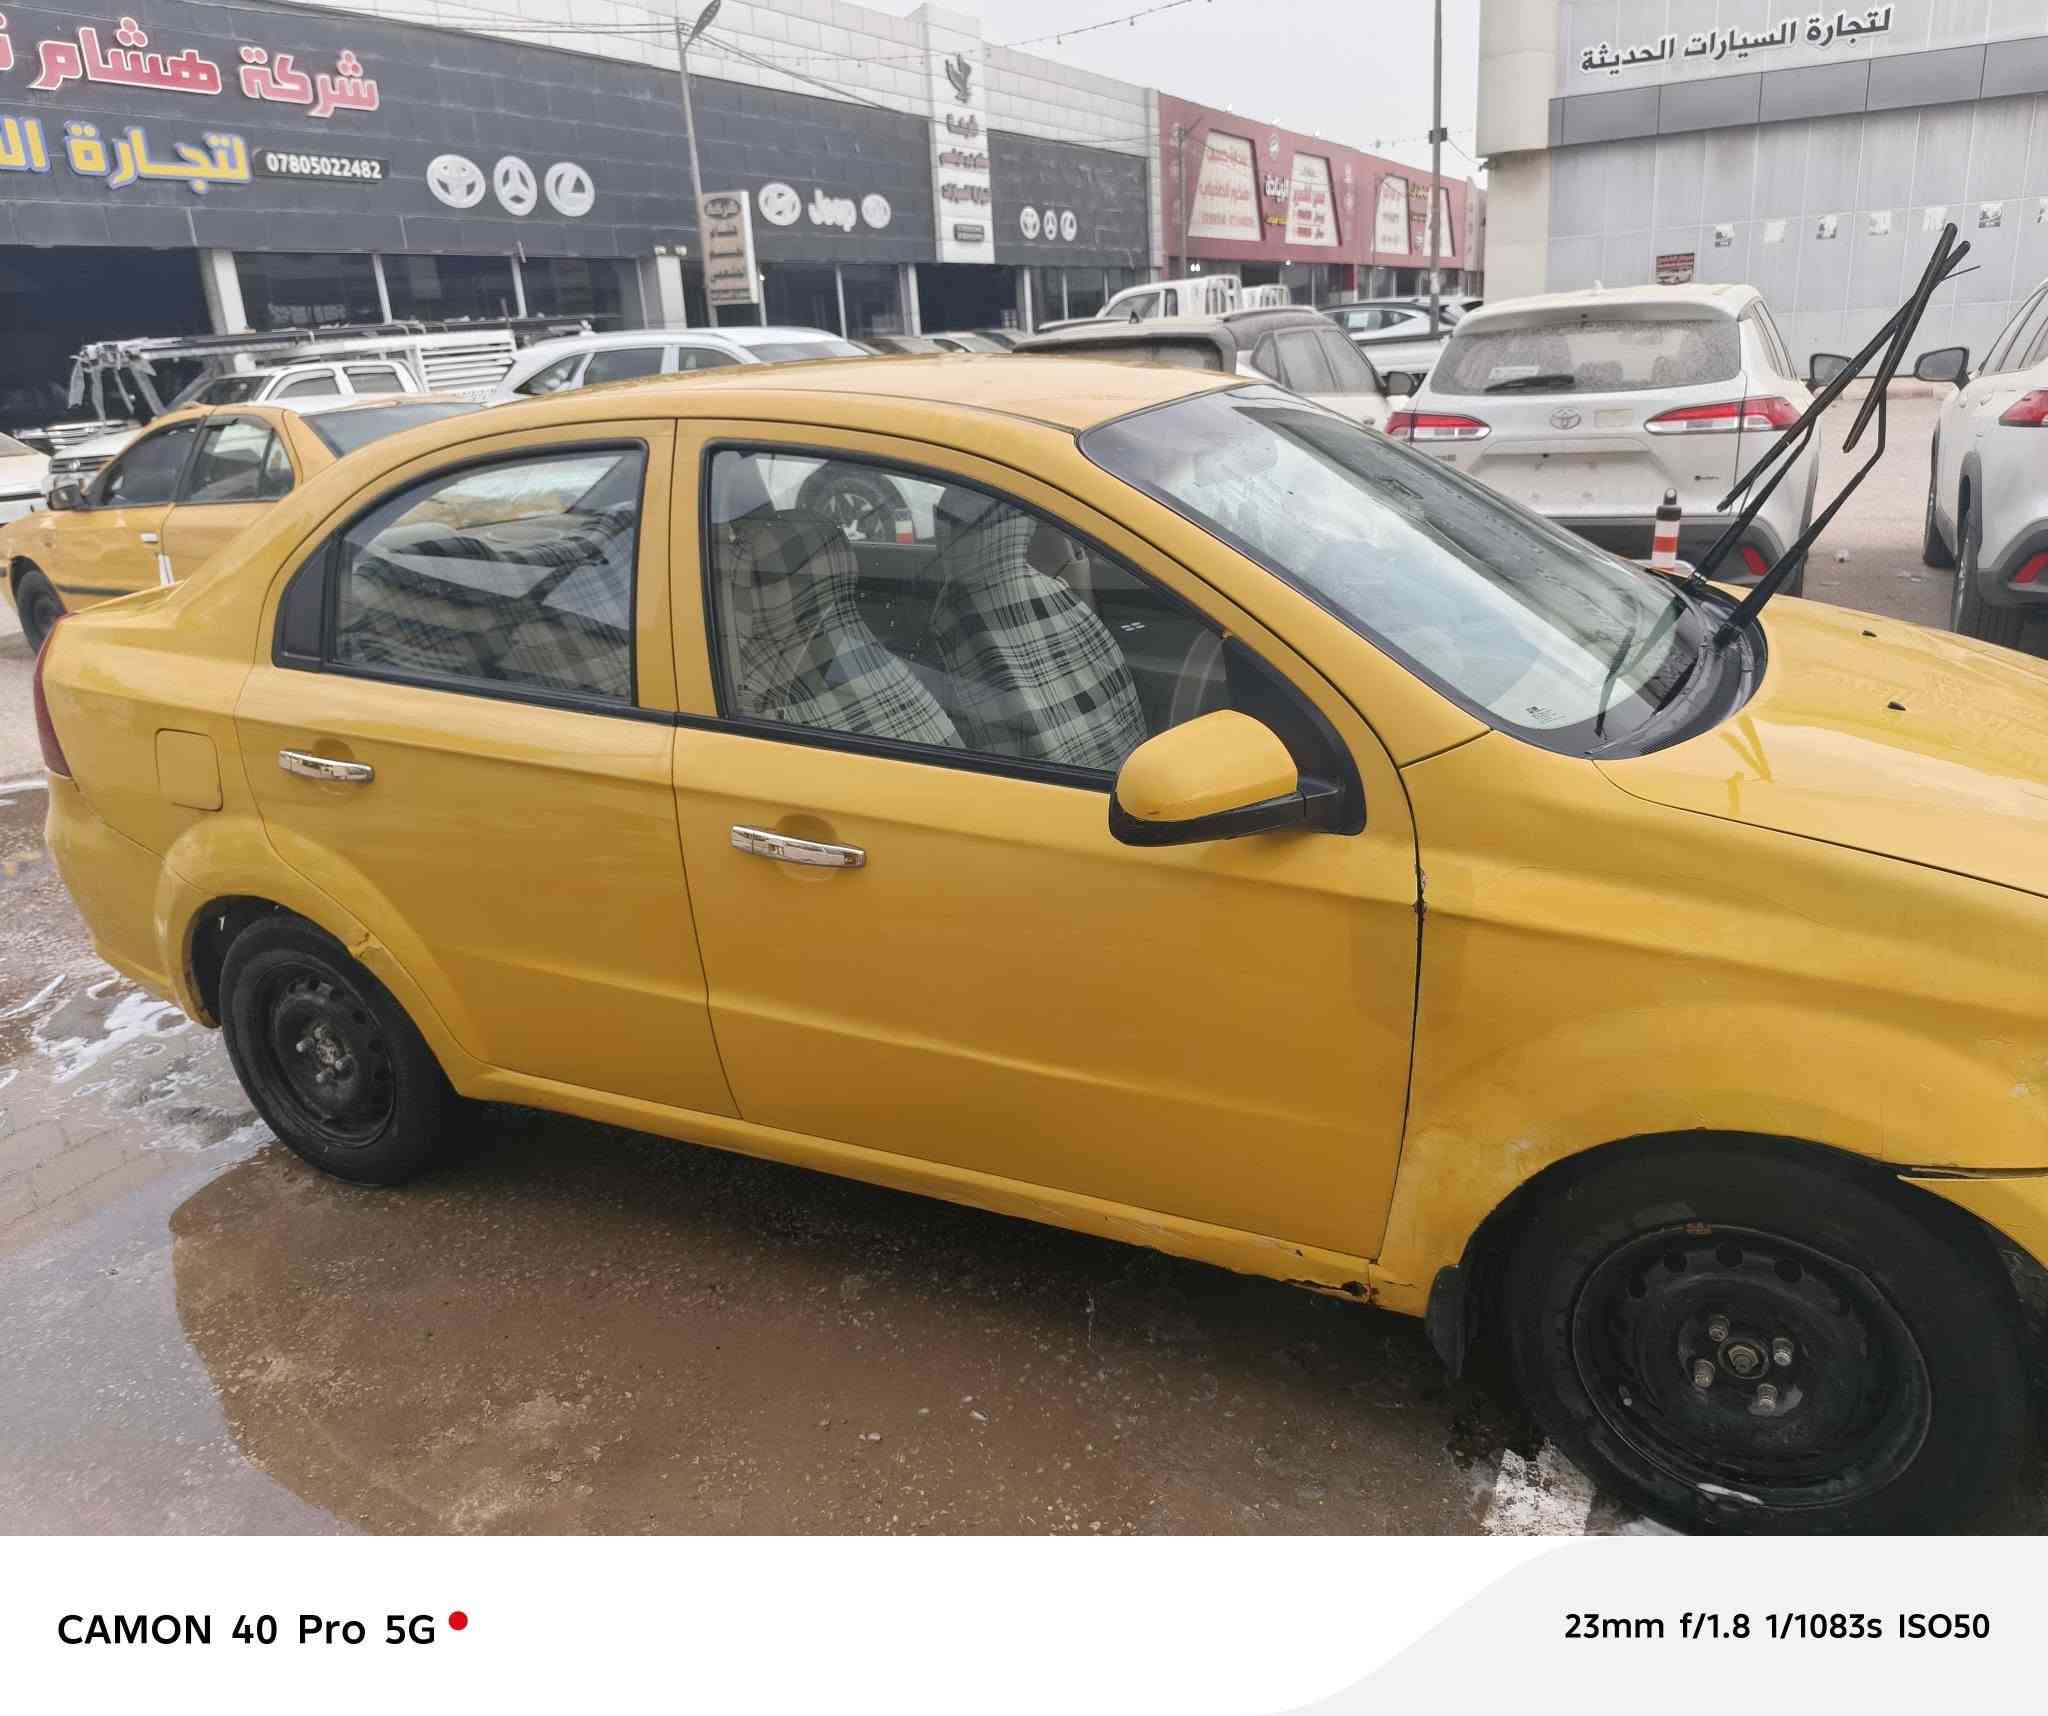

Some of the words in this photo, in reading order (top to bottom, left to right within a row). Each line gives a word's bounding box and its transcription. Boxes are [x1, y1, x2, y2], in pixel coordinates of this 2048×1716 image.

[1683, 20, 1797, 61] السيارات
[1804, 7, 1892, 47] لتجارة
[30, 17, 222, 94] هشام
[1580, 38, 1675, 75] الحديثة
[240, 47, 380, 118] شركة
[65, 121, 250, 194] لتجارة
[266, 152, 382, 179] 07805022482
